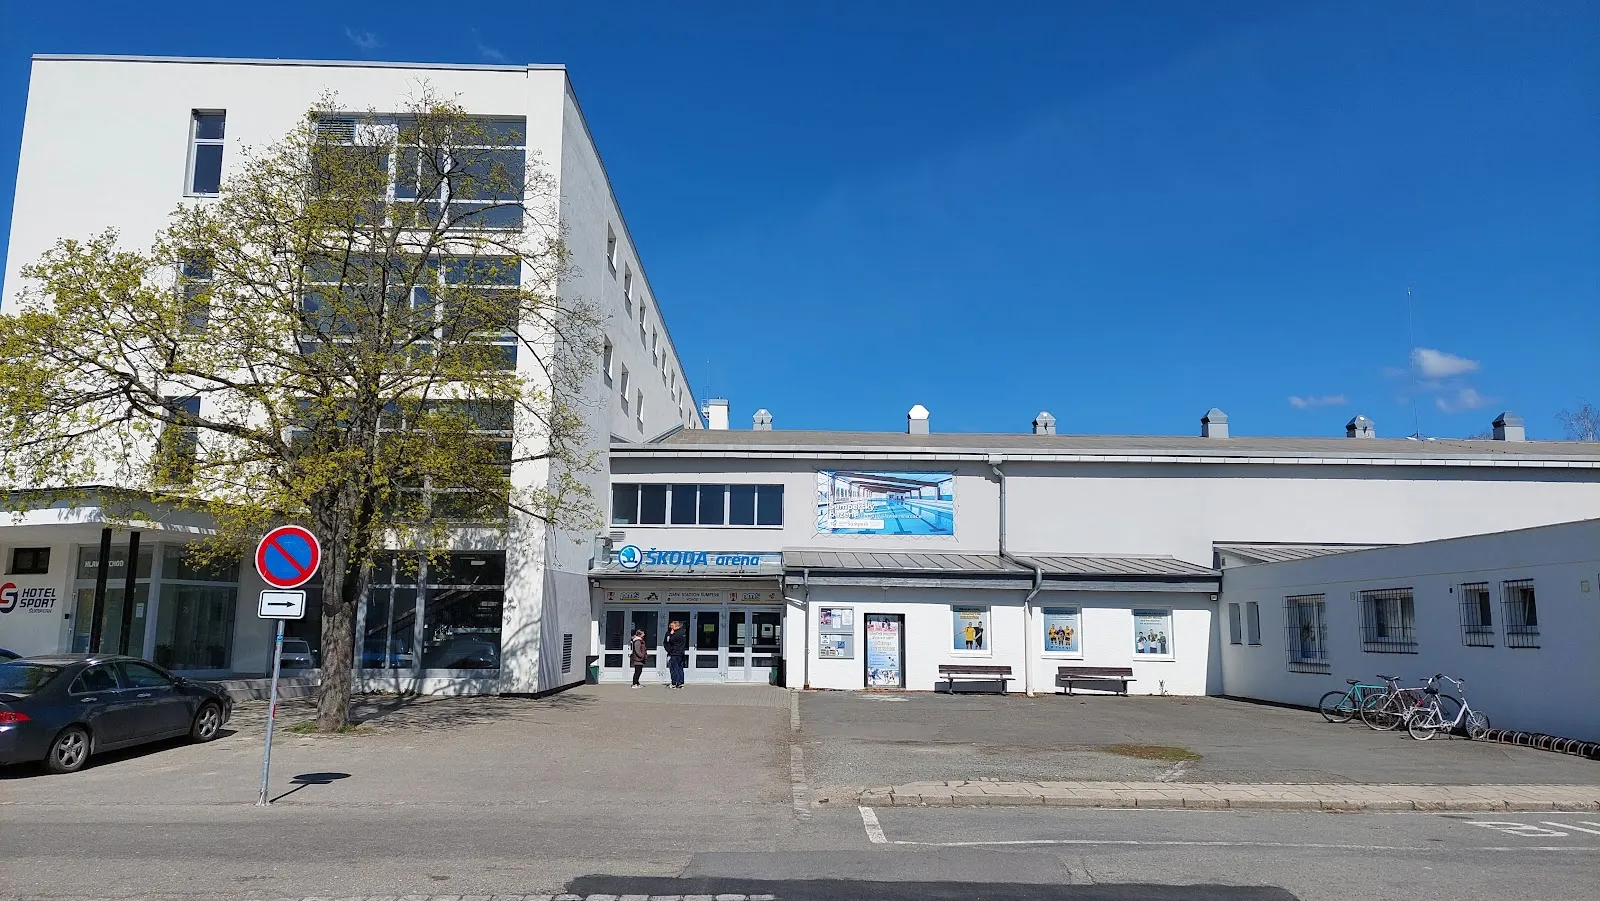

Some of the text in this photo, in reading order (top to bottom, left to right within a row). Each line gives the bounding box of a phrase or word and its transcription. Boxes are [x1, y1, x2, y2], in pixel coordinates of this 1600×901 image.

[645, 547, 708, 566] ŠKODA
[22, 588, 56, 598] HOTEL
[19, 598, 57, 608] SPORT
